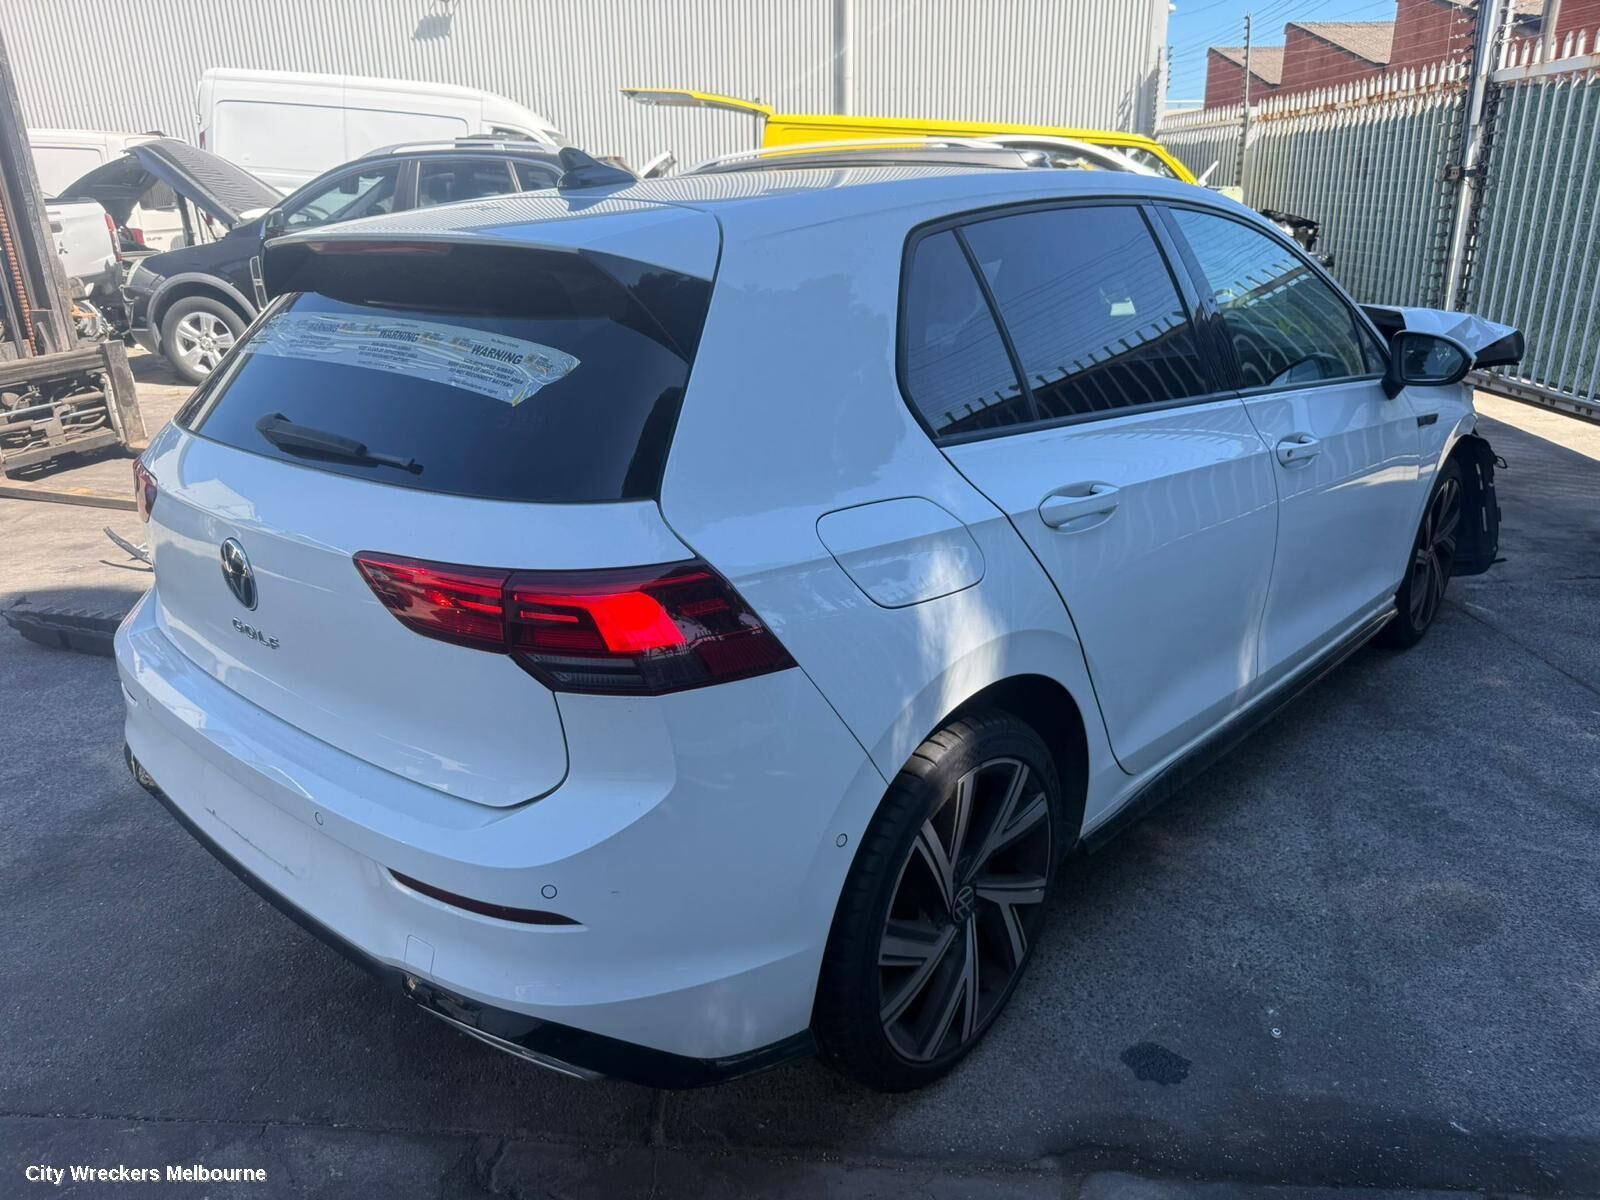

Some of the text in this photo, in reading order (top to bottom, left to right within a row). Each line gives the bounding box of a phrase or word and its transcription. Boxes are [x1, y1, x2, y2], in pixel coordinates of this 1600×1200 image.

[379, 328, 420, 342] WARNING
[471, 344, 523, 365] WARNING
[232, 616, 280, 650] GOLF
